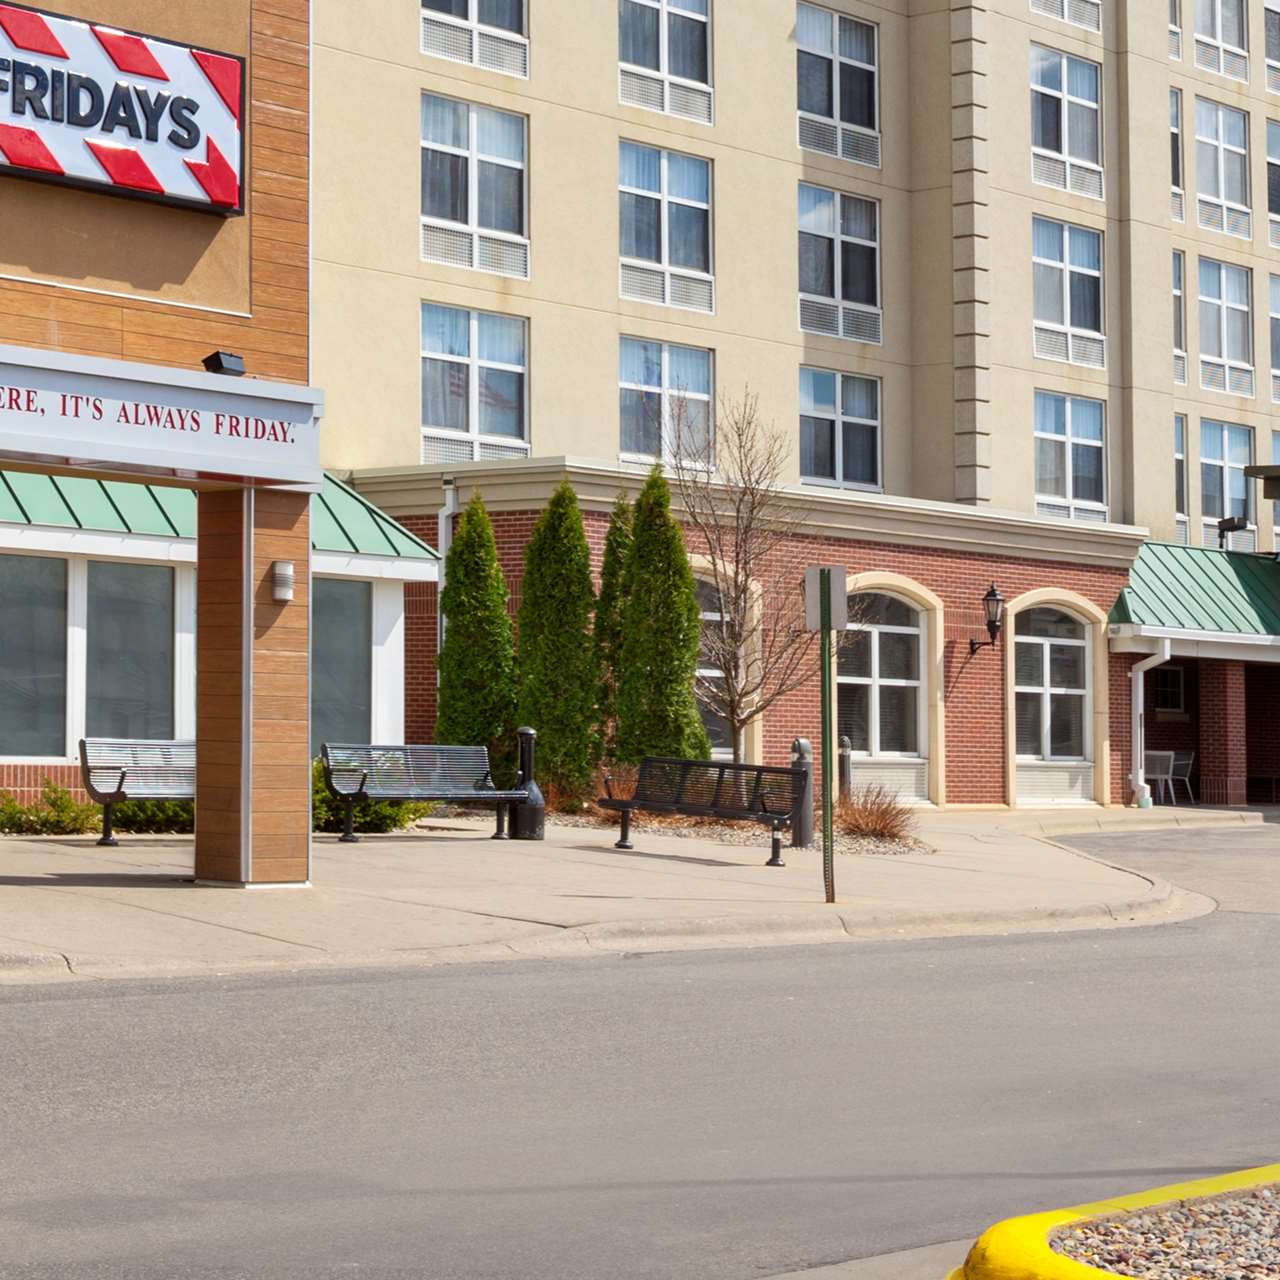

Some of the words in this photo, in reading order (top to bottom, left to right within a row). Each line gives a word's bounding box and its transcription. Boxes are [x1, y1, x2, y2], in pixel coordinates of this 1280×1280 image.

[60, 393, 104, 421] IT'S
[117, 402, 201, 433] ALWAYS
[214, 413, 295, 444] FRIDAY.
